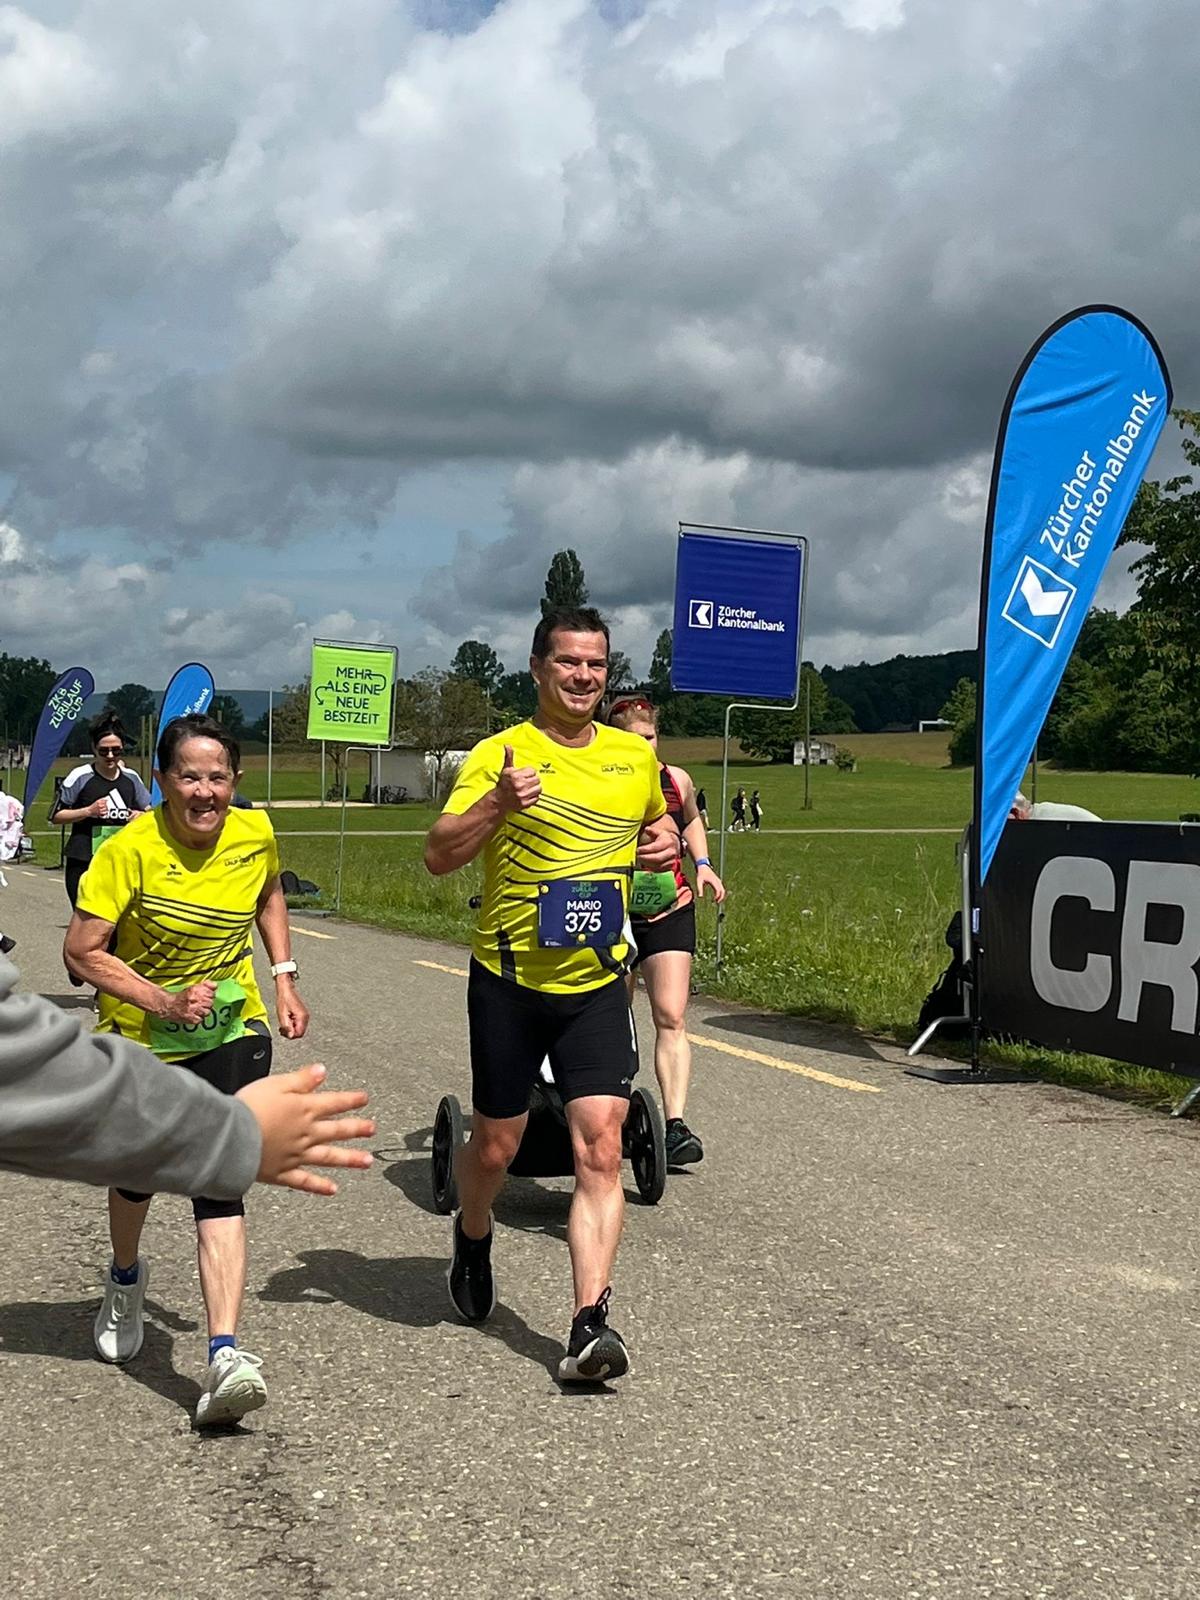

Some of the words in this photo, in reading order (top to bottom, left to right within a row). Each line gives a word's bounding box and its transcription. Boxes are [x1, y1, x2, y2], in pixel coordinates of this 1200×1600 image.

[1061, 388, 1157, 569] Kantonalbank
[1039, 449, 1097, 555] Zürcher
[718, 605, 756, 619] Zürcher
[717, 616, 785, 632] Kantonalbank
[335, 666, 373, 680] MEHR
[325, 680, 350, 693] ALS
[353, 682, 381, 696] EINE
[48, 687, 67, 711] ZKB
[49, 678, 82, 729] ZÜRILAUF
[336, 696, 370, 709] NEUE
[67, 696, 83, 720] CUP
[323, 709, 380, 724] BESTZEIT
[566, 900, 602, 911] MARIO
[631, 892, 663, 905] 1872
[564, 911, 602, 933] 375
[1031, 855, 1200, 1035] CR
